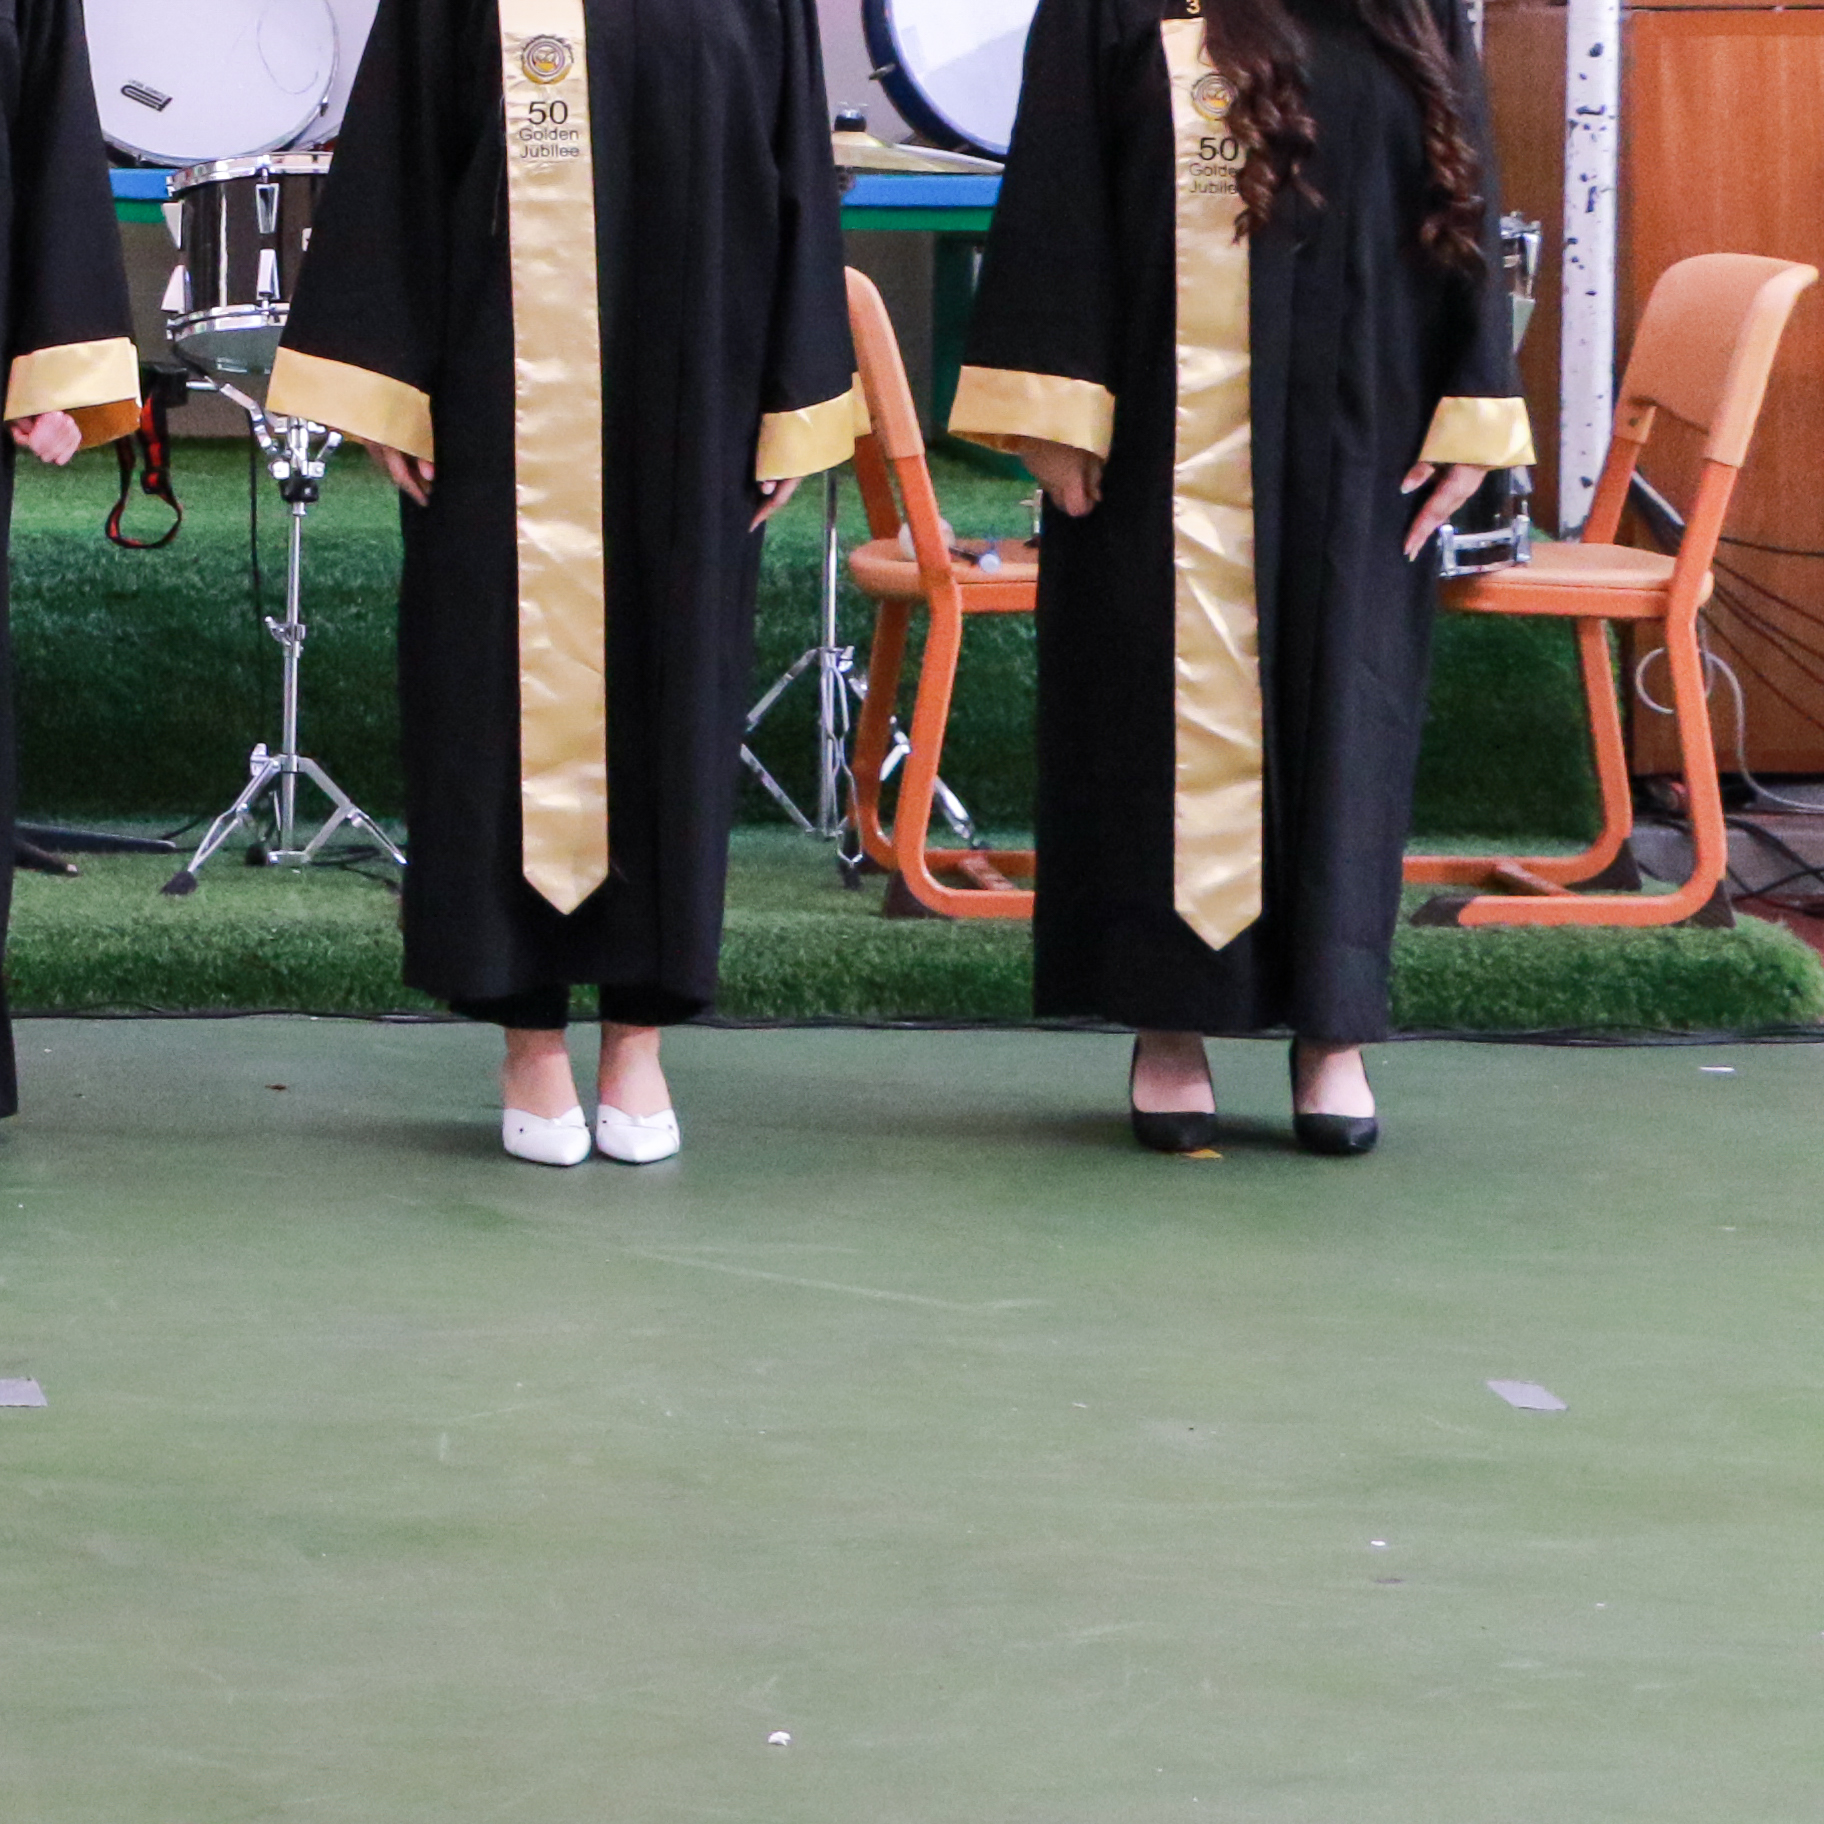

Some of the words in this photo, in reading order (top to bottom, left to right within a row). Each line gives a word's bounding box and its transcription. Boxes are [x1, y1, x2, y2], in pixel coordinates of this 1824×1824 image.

[528, 100, 569, 125] 50
[518, 128, 579, 143] Golden
[519, 143, 580, 159] Jubilee
[1198, 137, 1240, 162] 50
[1188, 162, 1237, 177] Golde
[1188, 179, 1238, 195] Jubile
